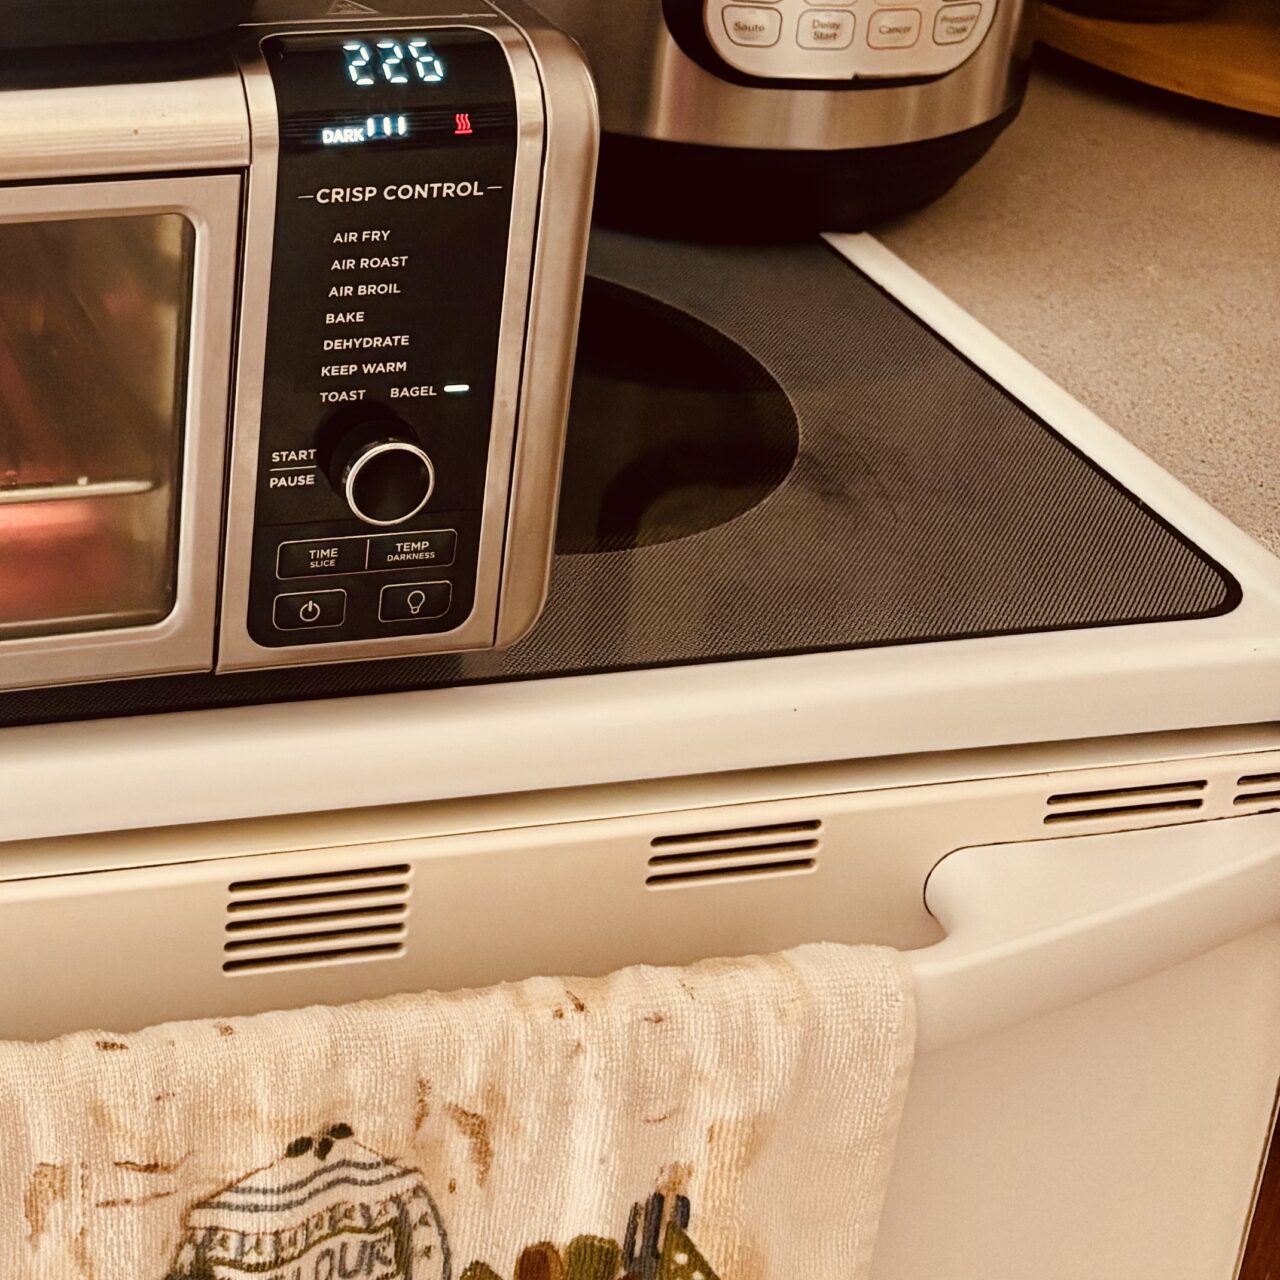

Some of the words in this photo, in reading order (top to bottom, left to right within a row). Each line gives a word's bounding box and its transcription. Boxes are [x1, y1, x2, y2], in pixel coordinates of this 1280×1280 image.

[813, 31, 838, 41] Start
[342, 40, 445, 86] 226
[321, 126, 366, 145] DARK
[315, 186, 378, 204] CRISP
[382, 181, 485, 201] CONTROL
[332, 231, 359, 244] AIR
[361, 230, 392, 243] FRY
[330, 258, 356, 271] AIR
[359, 256, 409, 269] ROAST
[328, 285, 354, 298] AIR
[357, 283, 402, 296] BROIL
[325, 311, 365, 325] BAKE
[323, 335, 410, 351] DEHYDRATE
[320, 364, 358, 377] KEEP
[361, 361, 408, 375] WARM
[319, 389, 367, 403] TOAST
[389, 385, 437, 399] BAGEL
[271, 448, 318, 463] START
[269, 474, 315, 489] PAUSE
[308, 547, 339, 560] TIME
[395, 540, 430, 553] TEMP
[386, 550, 436, 562] DARKNESS
[309, 559, 336, 569] SLICE
